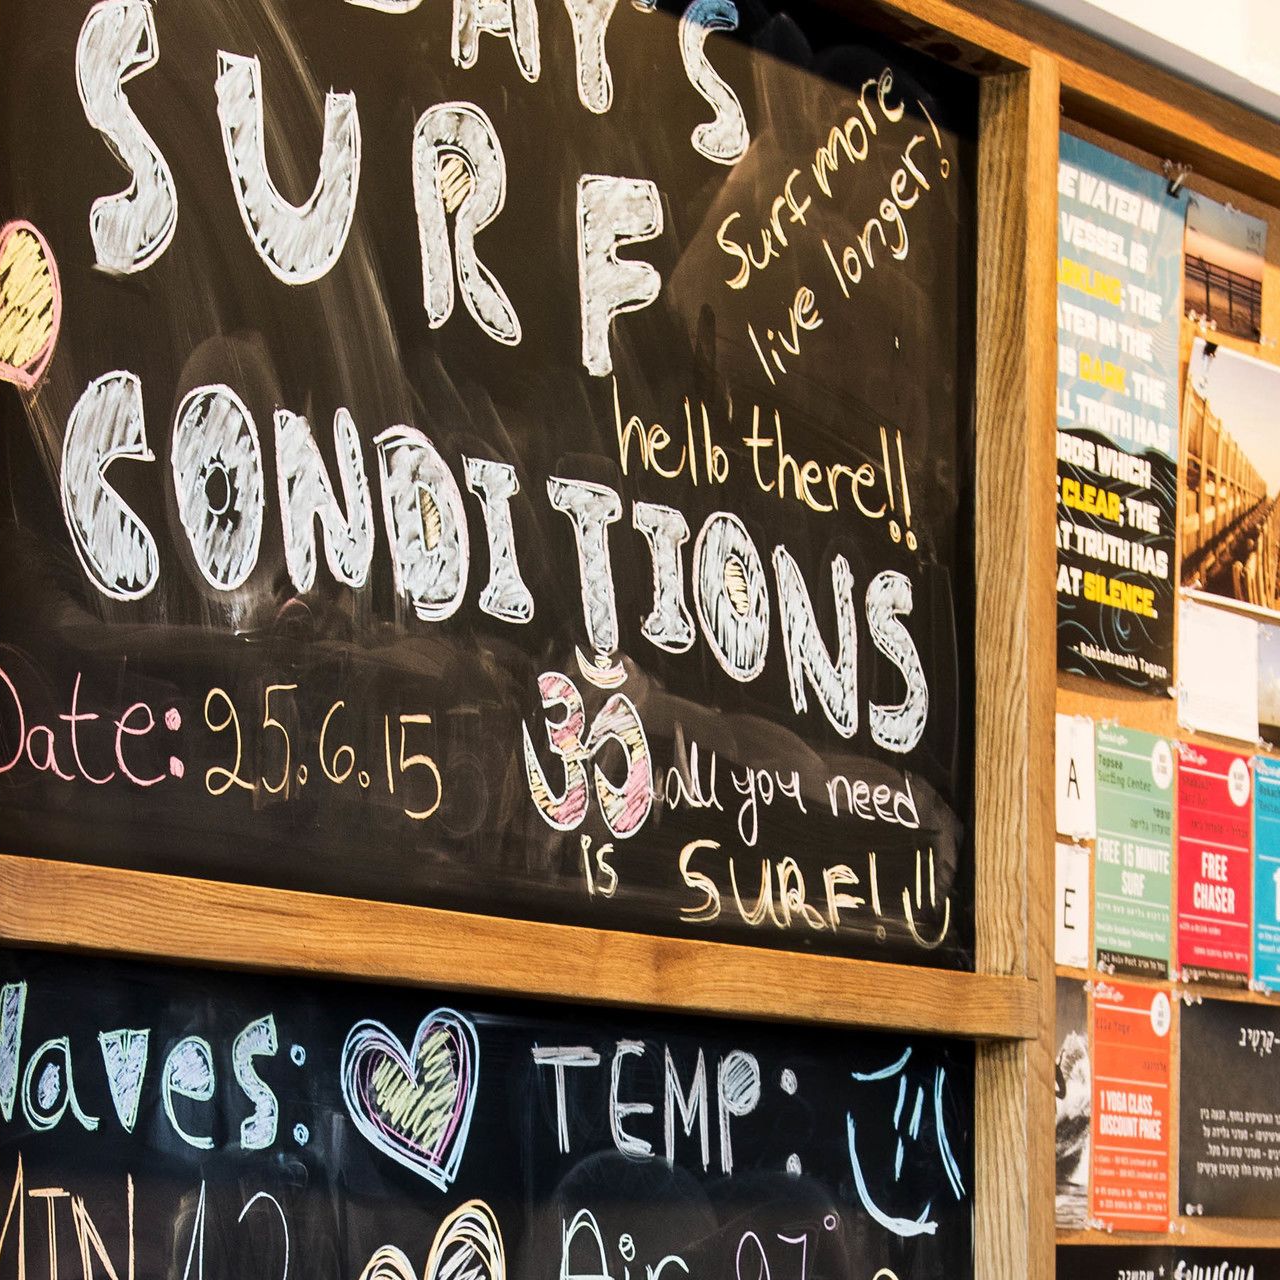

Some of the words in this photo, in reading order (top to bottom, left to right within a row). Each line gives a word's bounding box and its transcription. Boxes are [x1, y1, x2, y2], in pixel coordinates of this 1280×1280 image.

[76, 0, 664, 376] SURF
[718, 170, 812, 290] Surf
[812, 67, 905, 199] more
[1078, 169, 1144, 227] WATER
[1140, 202, 1161, 235] IN
[748, 287, 824, 385] live
[823, 100, 951, 298] longer!
[1061, 211, 1129, 268] VESSEL
[1129, 239, 1149, 274] IS
[1127, 283, 1163, 323] THE
[1098, 315, 1119, 349] IN
[1118, 322, 1153, 362] THE
[1131, 368, 1167, 410] THE
[1076, 394, 1133, 445] TRUTH
[1132, 415, 1170, 454] HAS
[612, 375, 730, 485] hello
[742, 405, 919, 551] there!!
[1096, 443, 1152, 491] WHICH
[1126, 497, 1162, 537] THE
[61, 370, 929, 754] CONDITIONS
[1074, 523, 1132, 573] TRUTH
[1131, 541, 1170, 581] HAS
[1082, 571, 1159, 619] SILENCE.
[204, 682, 443, 820] 25.6.15
[664, 741, 724, 811] all
[731, 767, 808, 847] you
[826, 768, 920, 830] need
[1097, 836, 1121, 866] FREE
[1135, 845, 1171, 876] MINUTE
[1120, 869, 1146, 899] SURF
[1201, 850, 1229, 882] FREE
[581, 834, 618, 899] is
[678, 838, 888, 943] SURF!
[1193, 881, 1236, 915] CHASER
[531, 1039, 803, 1177] TEMP:
[1099, 1112, 1139, 1139] DISCOUNT
[1139, 1116, 1162, 1142] PRICE
[1106, 1089, 1128, 1113] YOGA
[1128, 1092, 1153, 1117] CLASS
